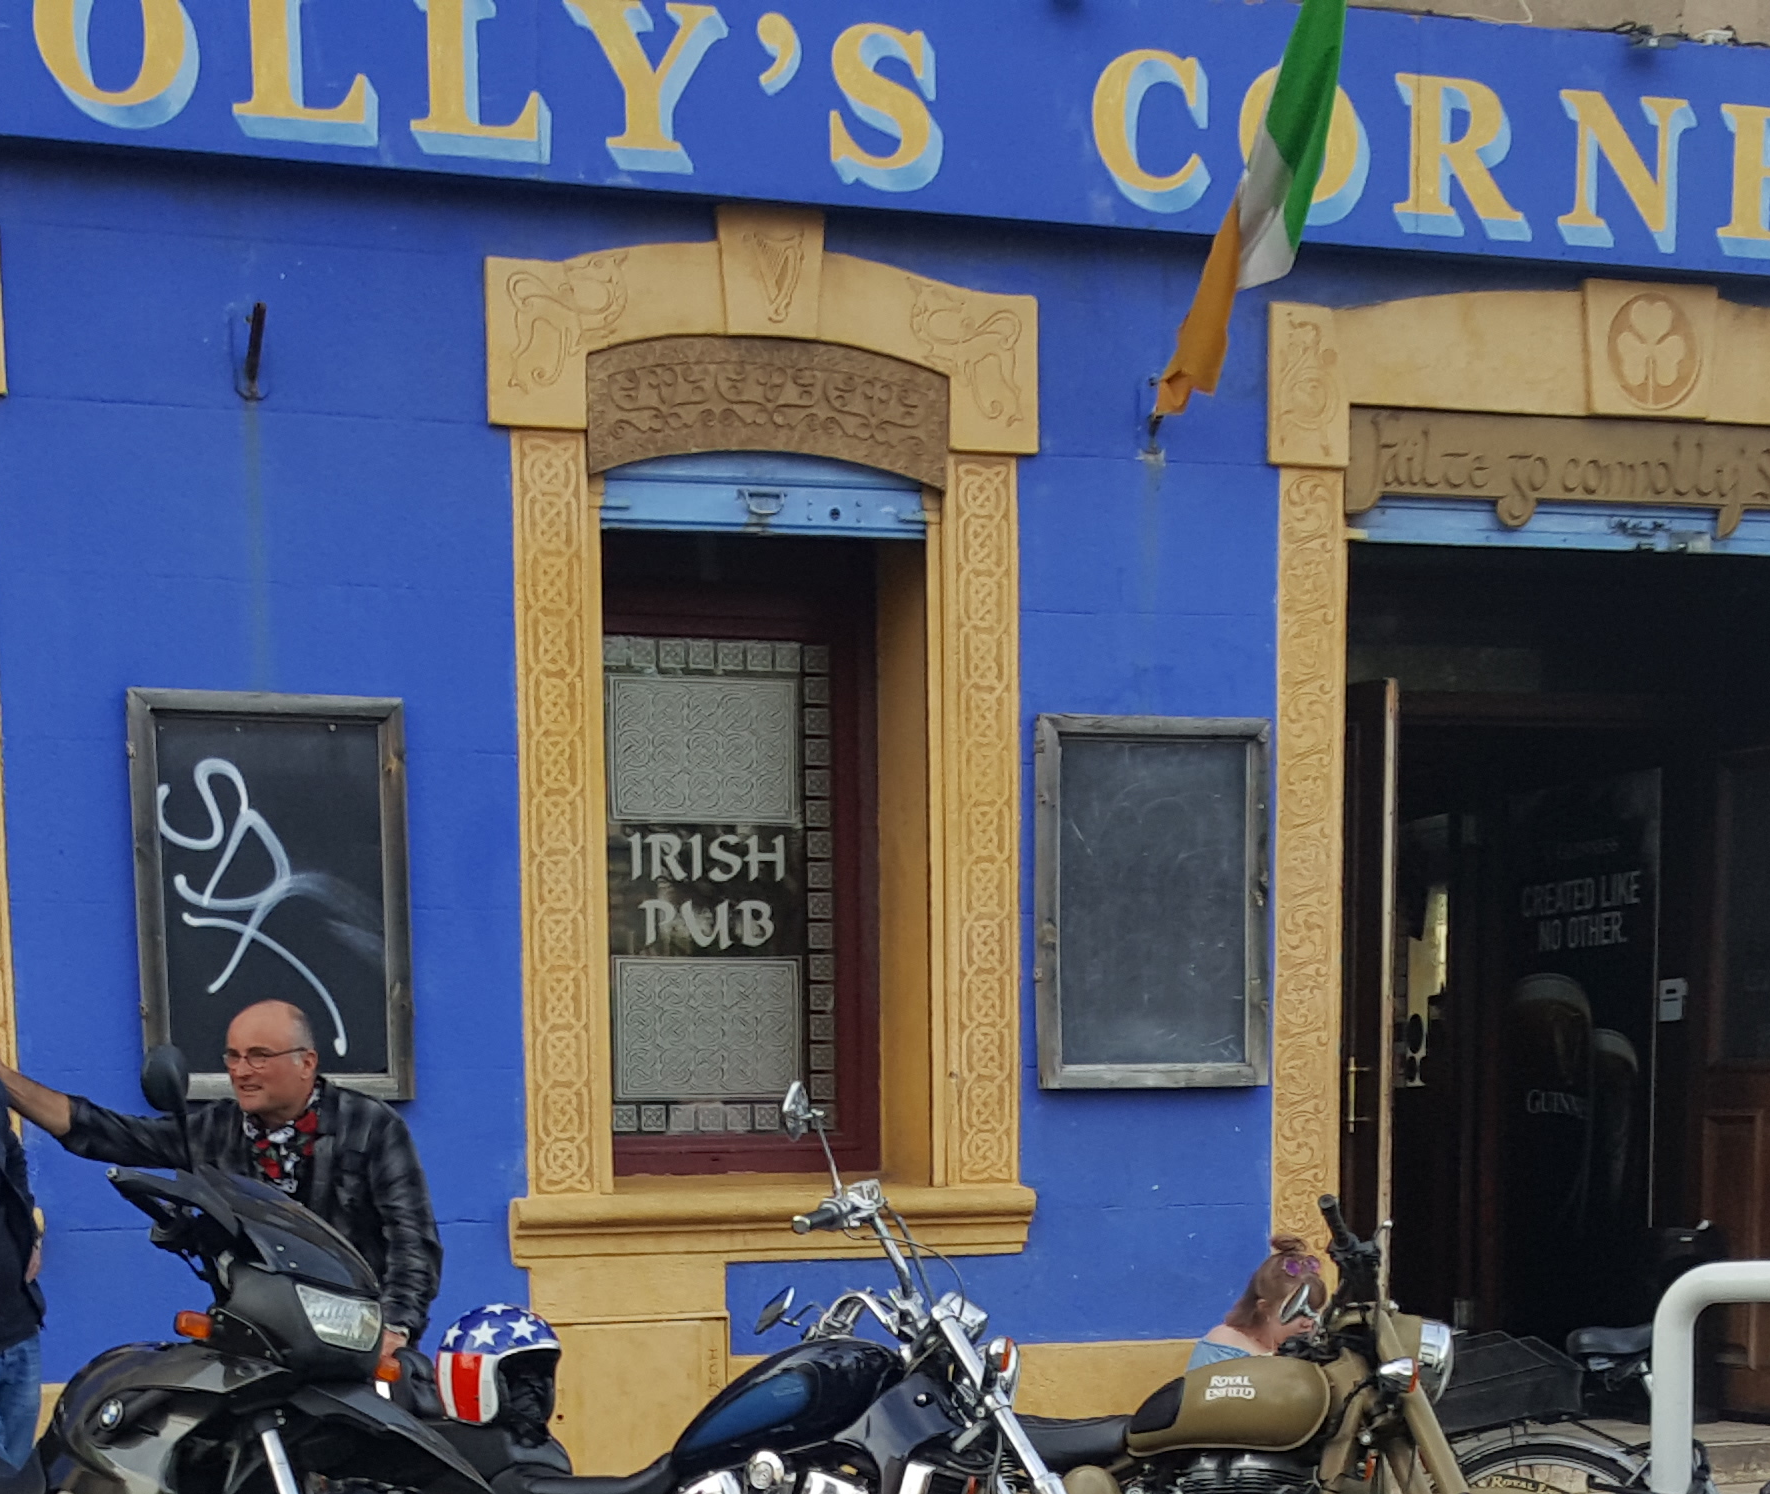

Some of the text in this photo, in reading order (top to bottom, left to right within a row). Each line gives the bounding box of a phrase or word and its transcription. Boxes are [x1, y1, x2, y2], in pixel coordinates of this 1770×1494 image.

[630, 832, 787, 883] IRISH
[1523, 870, 1641, 918] CREATED LIKE
[638, 899, 776, 949] PUB
[1539, 919, 1562, 951] NO
[1205, 1387, 1256, 1400] ENFIELD
[1210, 1375, 1253, 1387] ROYAL
[1491, 1475, 1536, 1491] ROYAL
